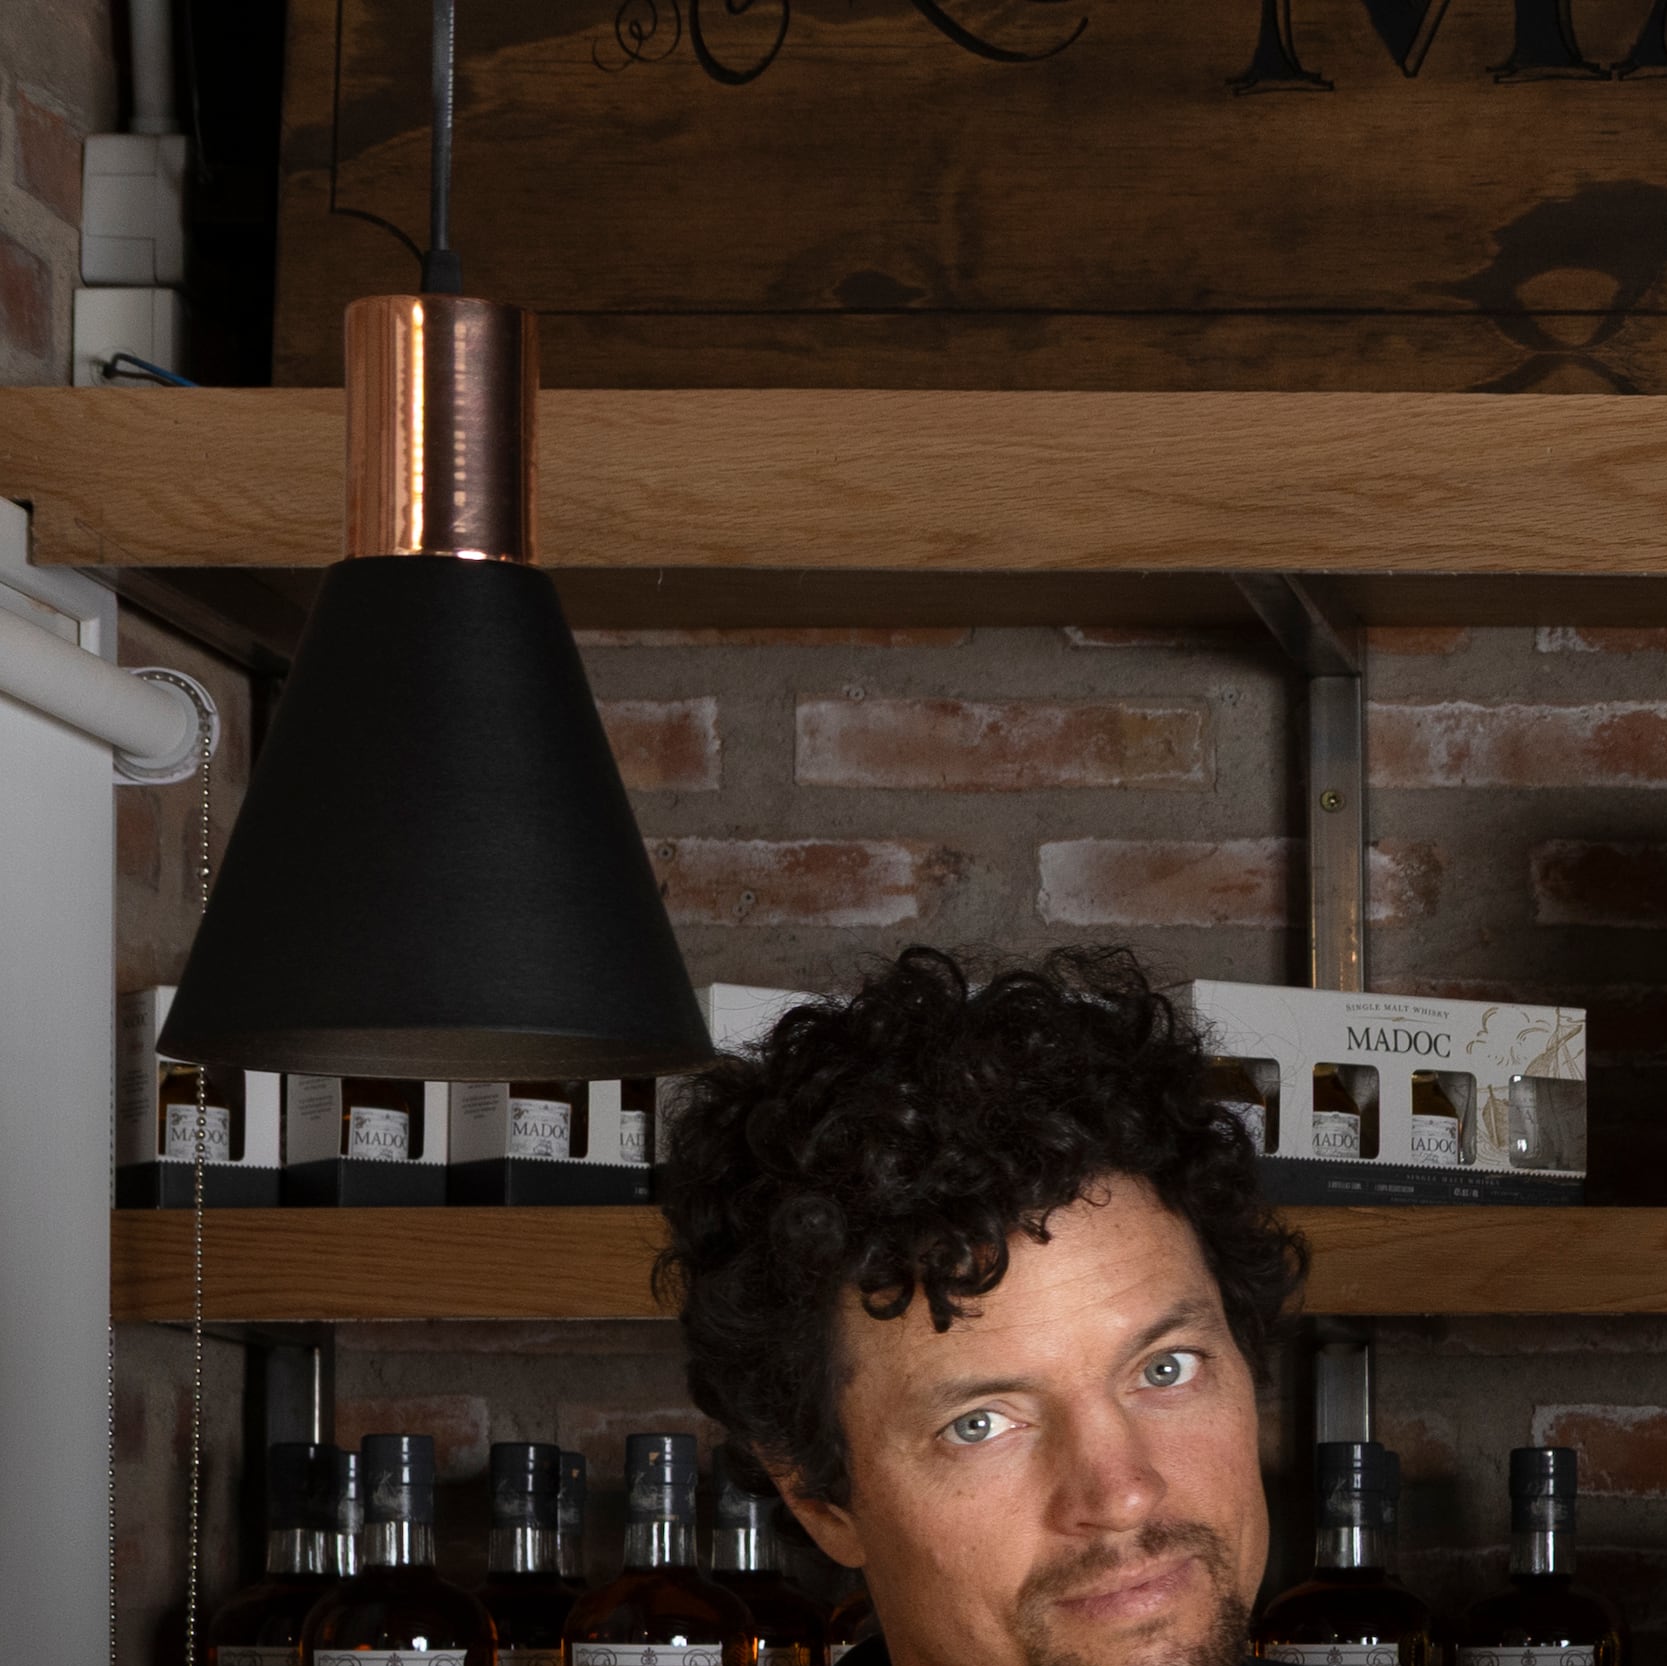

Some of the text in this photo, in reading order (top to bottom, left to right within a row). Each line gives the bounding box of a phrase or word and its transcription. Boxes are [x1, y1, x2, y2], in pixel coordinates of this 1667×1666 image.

[1346, 1003, 1450, 1019] SINGLE MALT WHISKY
[1346, 1026, 1451, 1058] MADOC
